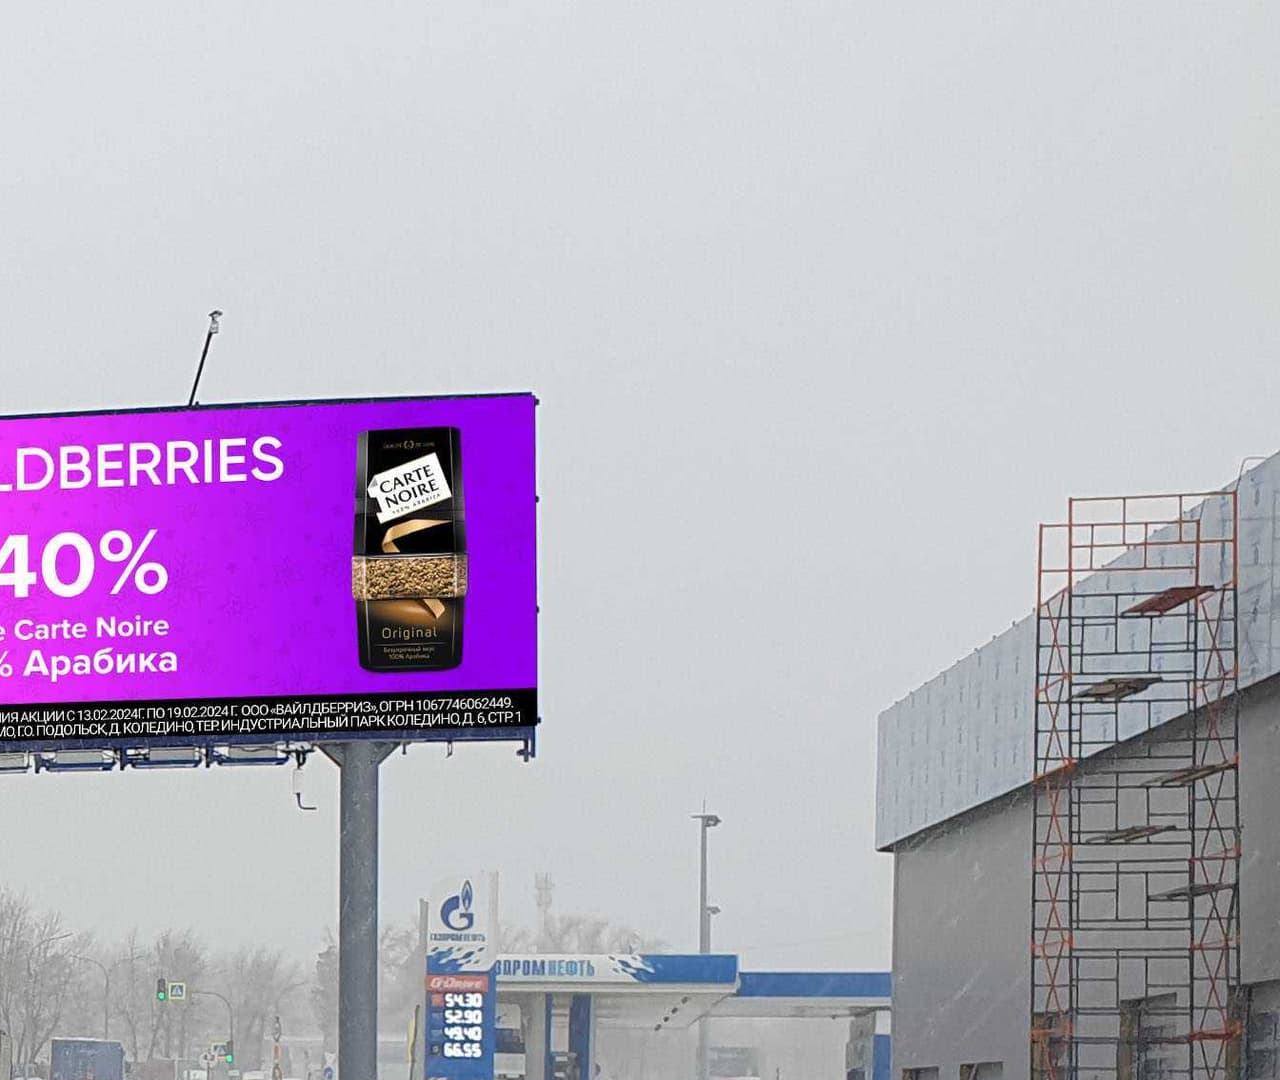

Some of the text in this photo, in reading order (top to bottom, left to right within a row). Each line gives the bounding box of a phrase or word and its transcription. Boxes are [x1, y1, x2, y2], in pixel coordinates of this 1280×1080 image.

[380, 464, 434, 493] CARTE
[384, 479, 439, 508] NOIRE
[13, 618, 88, 641] Carte
[95, 615, 170, 639] Noire
[382, 626, 437, 640] Original
[23, 647, 178, 683] Арабика
[20, 710, 65, 725] АКЦИИ
[66, 709, 76, 722] С
[146, 706, 166, 720] ПО
[241, 704, 270, 716] ООО
[270, 701, 379, 717] «ВАЙЛДБЕРРИЗ»,
[379, 700, 414, 713] ОГРН
[416, 697, 515, 712] 1067746062449.
[36, 723, 108, 739] ПОДОЛЬСК,
[123, 719, 195, 735] КОЛЕДИНО,
[221, 714, 349, 733] ИНДУСТРИАЛЬНЫЙ
[350, 714, 386, 728] ПАРК
[387, 712, 461, 728] КОЛЕДИНО,
[444, 993, 482, 1008] 54.30
[444, 1009, 482, 1024] 52.90
